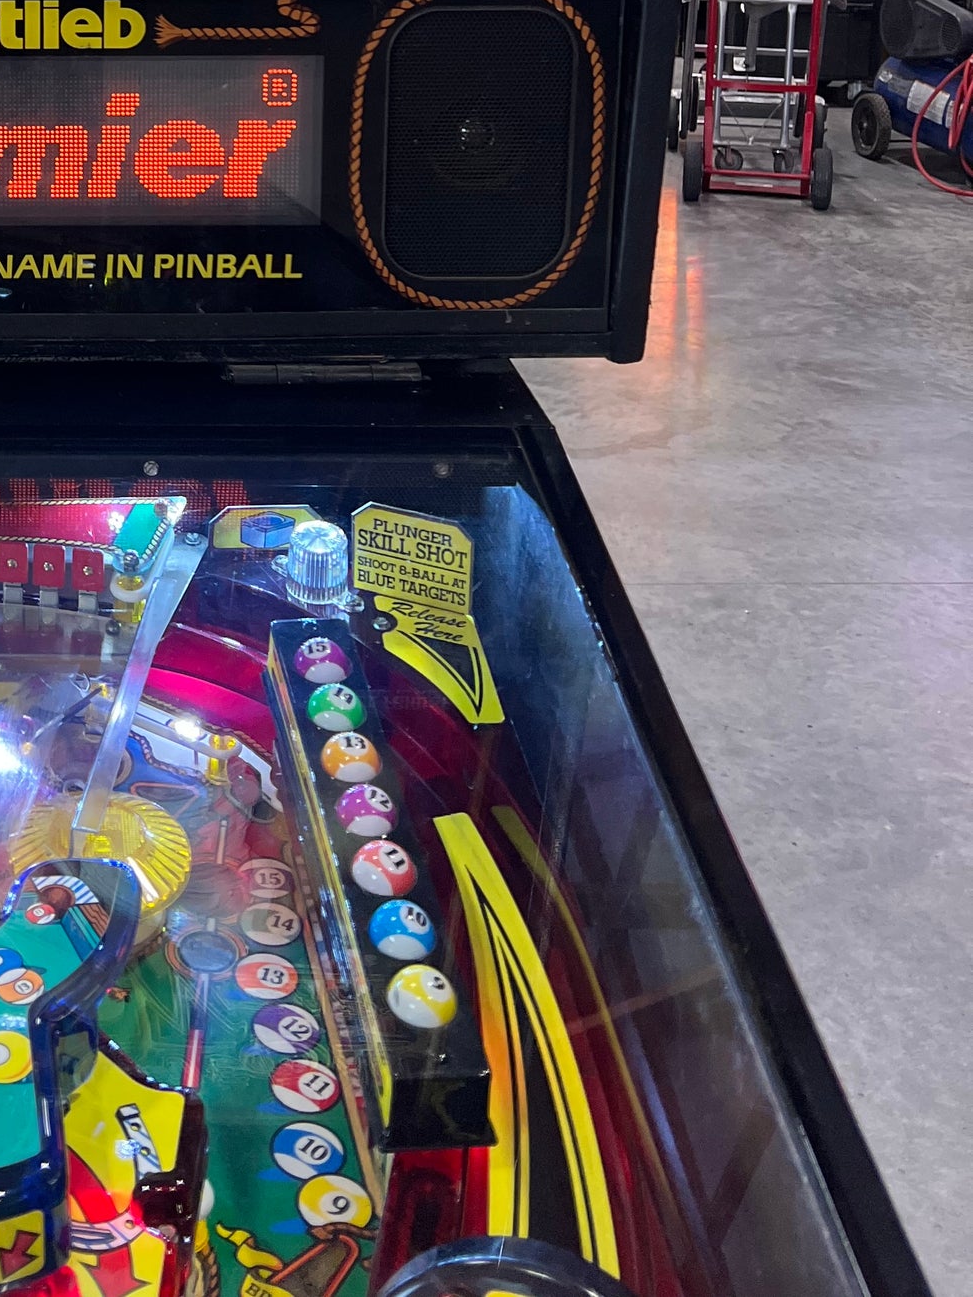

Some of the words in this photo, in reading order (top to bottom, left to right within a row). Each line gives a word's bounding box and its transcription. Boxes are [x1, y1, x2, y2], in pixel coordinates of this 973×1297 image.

[105, 254, 144, 280] IN
[154, 253, 303, 280] PINBALL
[373, 517, 452, 547] PLUNGER
[357, 529, 411, 557] SKILL
[415, 542, 467, 569] SHOT
[357, 555, 396, 573] SHOOT
[399, 565, 449, 586] 8-BALL
[451, 577, 466, 589] AT
[356, 568, 396, 590] BLUE
[399, 578, 466, 606] TARGETS
[388, 602, 467, 628] Release
[414, 621, 464, 642] Here
[306, 642, 327, 655] 15
[334, 687, 354, 705] 14
[344, 736, 366, 750] 13
[370, 789, 390, 809] 12
[385, 848, 406, 869] 11
[258, 872, 282, 886] 15
[270, 915, 295, 932] 14
[406, 906, 427, 927] 10
[259, 967, 285, 985] 13
[282, 1017, 311, 1040] 12
[303, 1074, 331, 1096] 11
[298, 1138, 329, 1161] 10
[327, 1195, 351, 1216] 9
